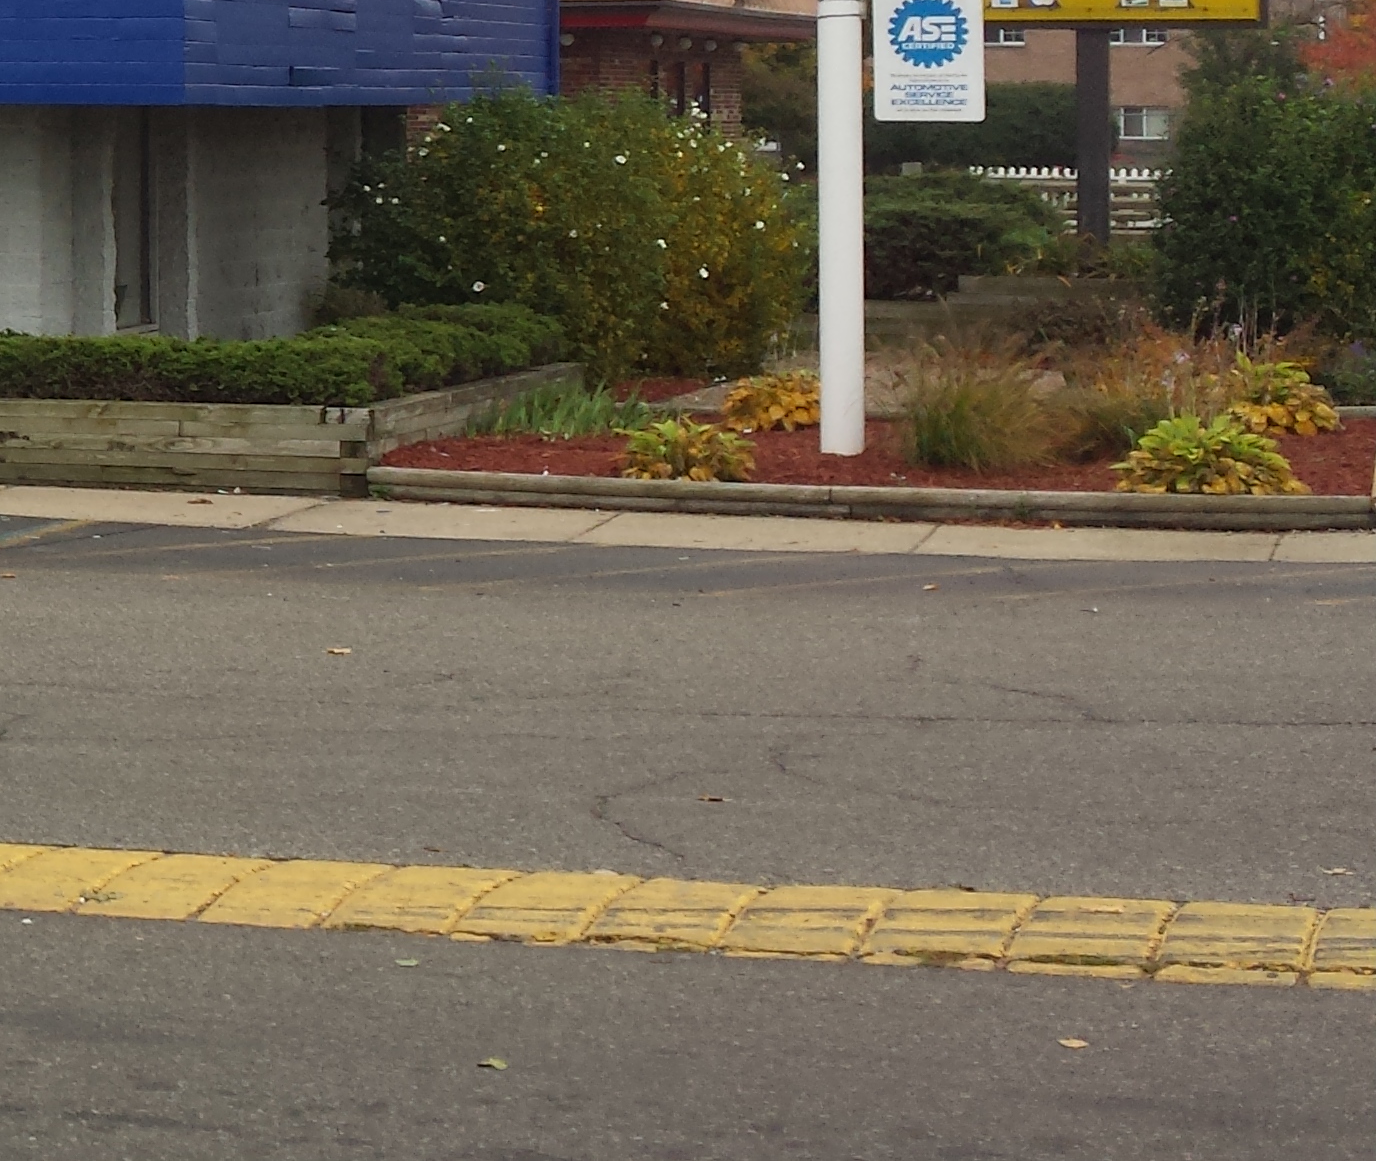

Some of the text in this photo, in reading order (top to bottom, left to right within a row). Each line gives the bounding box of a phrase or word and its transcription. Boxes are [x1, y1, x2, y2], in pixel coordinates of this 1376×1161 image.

[897, 15, 957, 42] ASE
[901, 42, 956, 51] CERTIFIED
[905, 91, 954, 99] SERVICE
